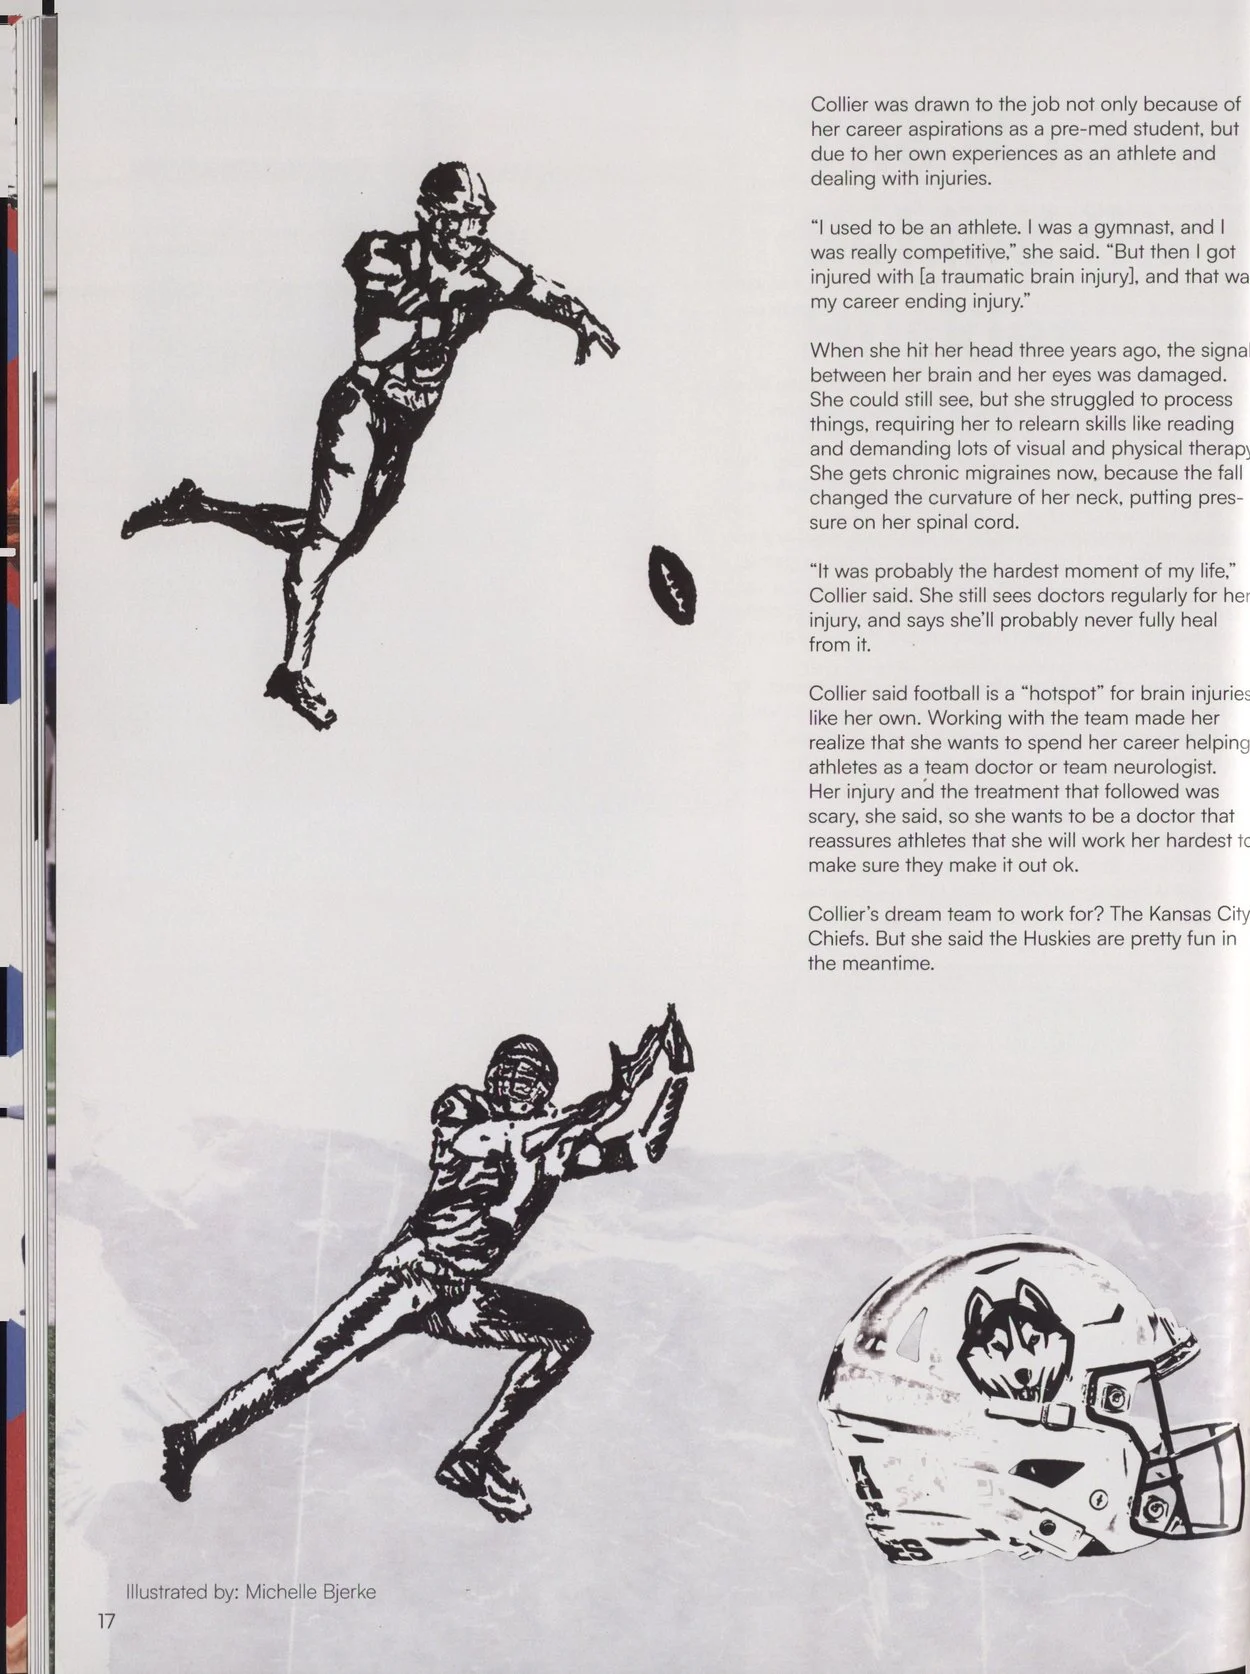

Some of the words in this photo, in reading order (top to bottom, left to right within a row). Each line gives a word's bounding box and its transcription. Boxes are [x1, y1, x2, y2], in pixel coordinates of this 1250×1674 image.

[810, 95, 869, 113] Collier
[874, 100, 909, 113] was
[914, 95, 970, 113] drawn
[975, 97, 993, 112] to
[998, 95, 1027, 112] the
[1030, 95, 1061, 117] job
[1066, 96, 1096, 112] not
[1100, 95, 1138, 116] only
[1143, 95, 1219, 112] because
[1223, 95, 1242, 112] of
[811, 120, 841, 137] her
[845, 124, 903, 137] career
[908, 120, 1004, 141] aspirations
[1008, 124, 1029, 137] as
[1034, 124, 1044, 137] a
[1050, 119, 1128, 141] pre-med
[1133, 119, 1204, 138] student,
[1210, 119, 1240, 137] but
[810, 144, 845, 162] due
[850, 146, 869, 162] to
[874, 144, 904, 162] her
[908, 149, 947, 162] own
[952, 144, 1058, 165] experiences
[1063, 148, 1083, 161] as
[1088, 148, 1111, 161] an
[1116, 144, 1177, 161] athlete
[1182, 144, 1216, 161] and
[810, 169, 876, 191] dealing
[881, 169, 919, 186] with
[925, 169, 992, 191] injuries.
[830, 218, 872, 236] used
[877, 220, 896, 236] to
[901, 218, 924, 236] be
[929, 223, 952, 236] an
[957, 218, 1022, 235] athlete.
[1028, 218, 1032, 235] I
[1037, 222, 1072, 235] was
[1078, 222, 1089, 235] a
[1094, 219, 1175, 240] gymnast,
[1180, 218, 1214, 235] and
[1221, 218, 1225, 235] I
[810, 247, 845, 260] was
[851, 243, 898, 264] really
[1022, 242, 1054, 260] she
[1059, 242, 1100, 260] said.
[1149, 242, 1190, 260] then
[1196, 243, 1200, 260] I
[1206, 244, 1237, 264] got
[810, 267, 871, 289] injured
[876, 267, 914, 285] with
[919, 266, 936, 286] [a
[941, 267, 1025, 285] traumatic
[1030, 267, 1075, 285] brain
[1080, 266, 1139, 289] injury],
[1145, 267, 1179, 284] and
[1184, 267, 1220, 285] that
[810, 297, 838, 314] my
[842, 296, 900, 310] career
[904, 292, 967, 314] ending
[809, 341, 864, 359] When
[869, 341, 901, 359] she
[906, 341, 929, 358] hit
[934, 341, 964, 358] her
[969, 341, 1013, 358] head
[1018, 341, 1065, 358] three
[1069, 345, 1117, 362] years
[1122, 345, 1161, 362] ago,
[1166, 341, 1196, 358] the
[834, 566, 869, 579] was
[875, 561, 954, 583] probably
[958, 562, 988, 579] the
[993, 562, 1060, 579] hardest
[1065, 563, 1140, 579] moment
[1144, 561, 1163, 579] of
[1168, 566, 1195, 583] my
[809, 586, 868, 604] Collier
[872, 586, 913, 604] said.
[919, 586, 954, 604] She
[958, 586, 987, 604] still
[992, 591, 1032, 604] sees
[1037, 586, 1105, 604] doctors
[1111, 586, 1188, 608] regularly
[1192, 586, 1218, 603] for
[809, 611, 861, 633] injury,
[867, 611, 901, 628] and
[906, 615, 945, 632] says
[1000, 610, 1079, 632] probably
[1084, 615, 1134, 628] never
[1138, 610, 1176, 632] fully
[1181, 610, 1218, 628] heal
[808, 635, 851, 653] from
[856, 635, 871, 653] it.
[884, 905, 942, 922] dream
[947, 906, 992, 922] team
[997, 906, 1016, 922] to
[1020, 905, 1064, 922] work
[1068, 904, 1105, 922] for?
[1109, 905, 1144, 922] The
[1149, 905, 1212, 922] Kansas
[1217, 904, 1250, 926] City
[808, 929, 869, 947] Chiefs.
[876, 929, 906, 947] But
[911, 929, 943, 947] she
[947, 929, 984, 947] said
[988, 929, 1018, 947] the
[1023, 929, 1091, 947] Huskies
[1096, 934, 1125, 947] are
[1130, 931, 1183, 951] pretty
[1186, 929, 1216, 947] fun
[1222, 929, 1237, 946] in
[807, 954, 837, 971] the
[842, 954, 935, 971] meantime.
[126, 1582, 208, 1600] Illustrated
[213, 1582, 239, 1603] by:
[245, 1582, 317, 1600] Michelle
[323, 1582, 377, 1603] Bjerke
[98, 1612, 116, 1629] 17
